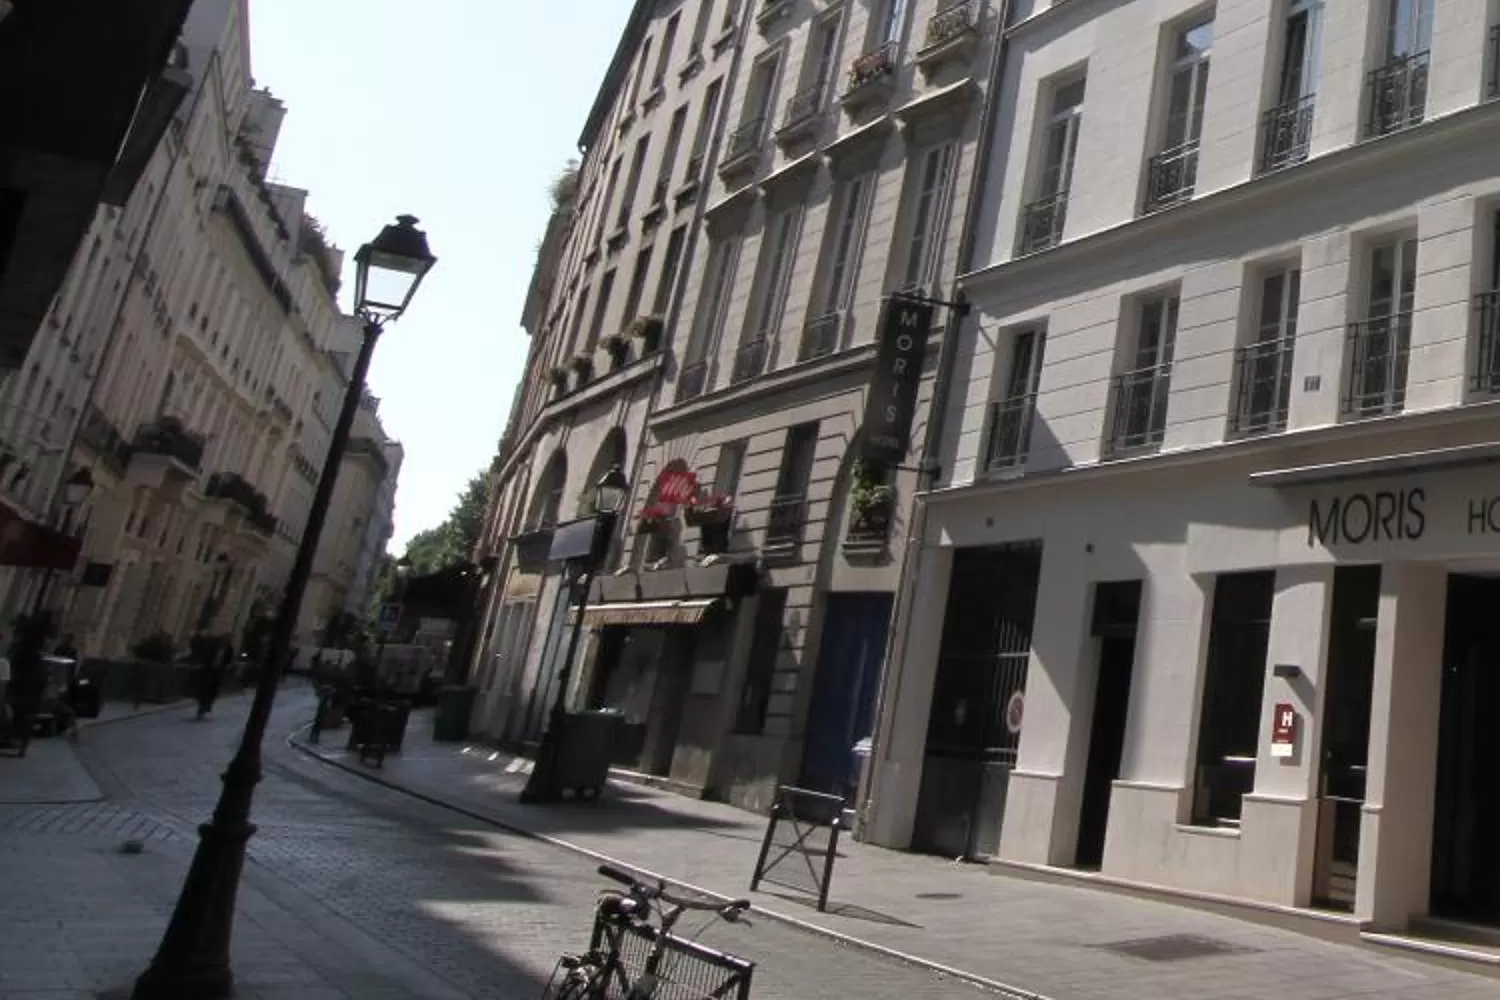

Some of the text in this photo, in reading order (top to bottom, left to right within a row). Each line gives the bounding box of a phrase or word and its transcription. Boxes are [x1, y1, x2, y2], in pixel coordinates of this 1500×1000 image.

[885, 311, 918, 422] MORIS
[1308, 487, 1426, 549] MORIS
[1281, 711, 1293, 727] H
